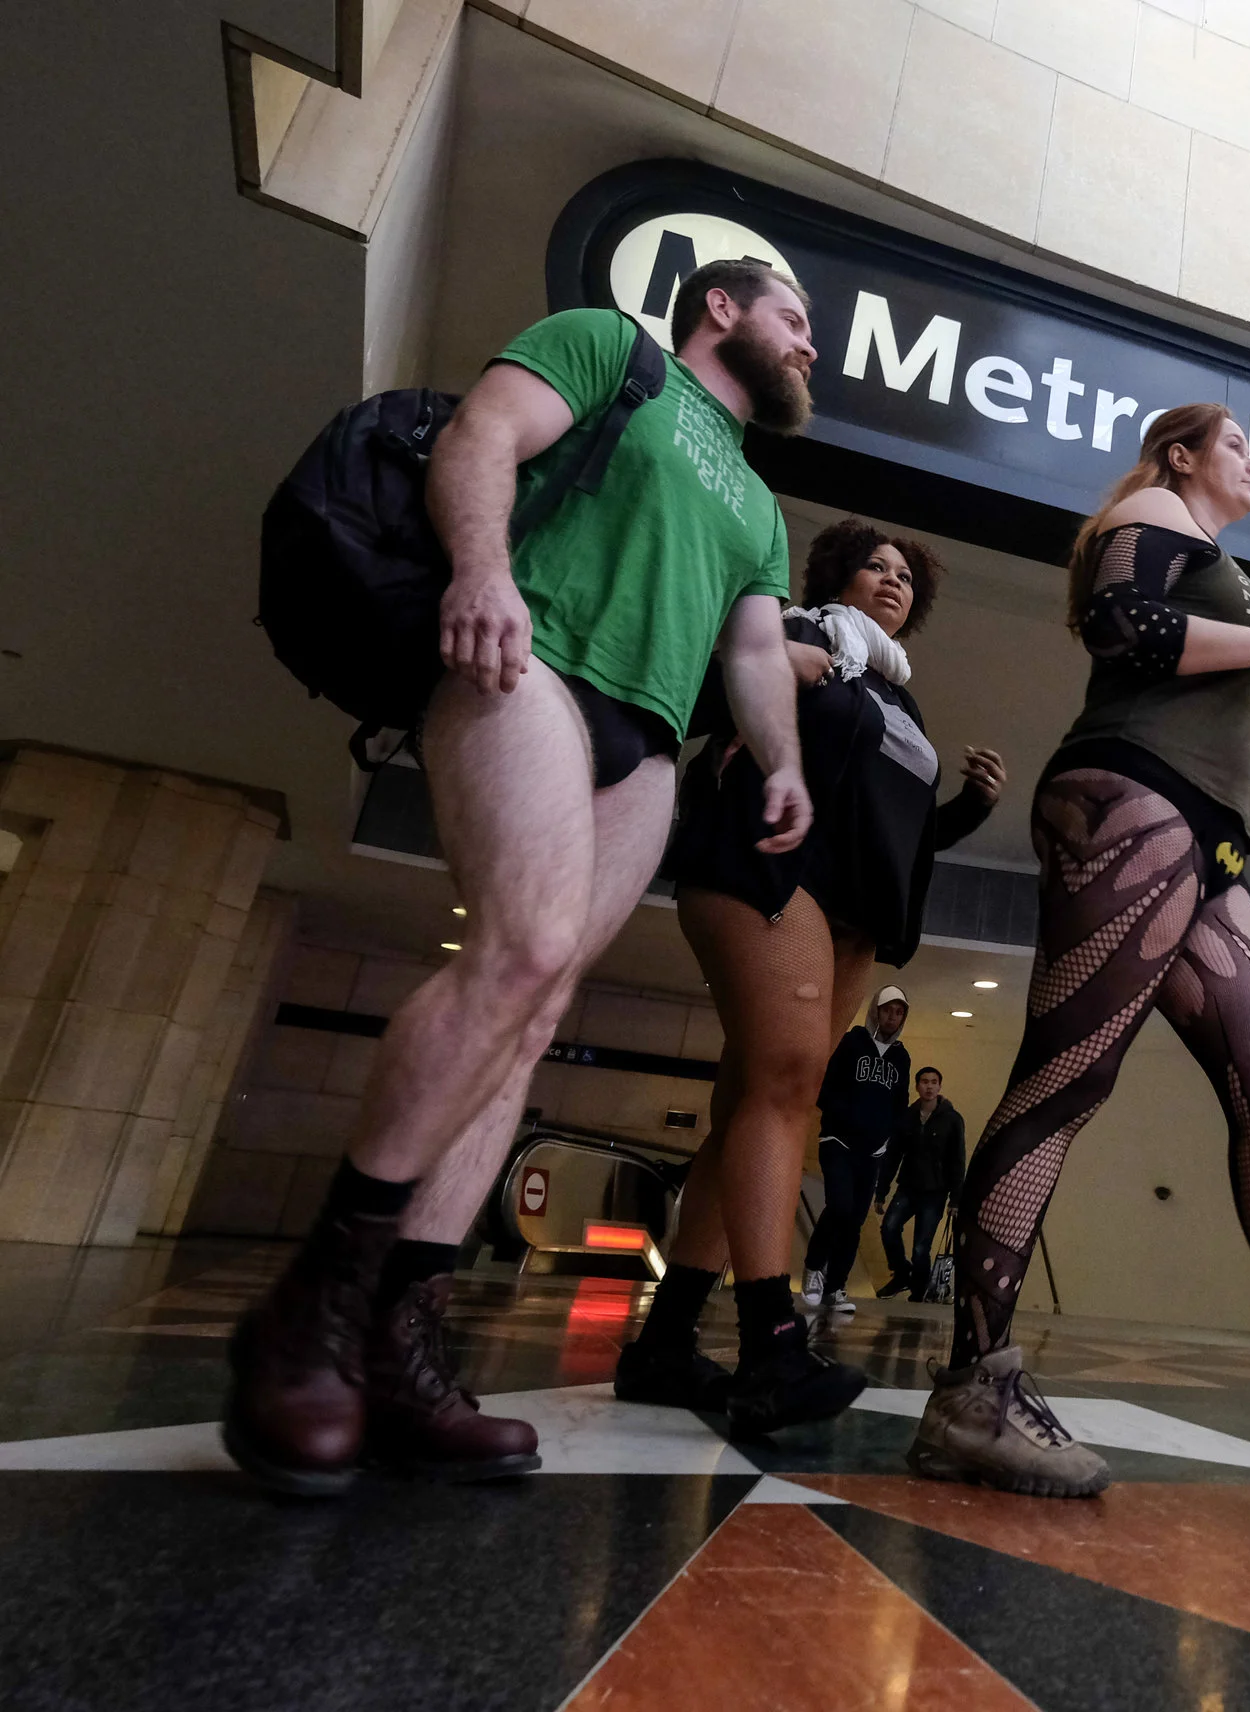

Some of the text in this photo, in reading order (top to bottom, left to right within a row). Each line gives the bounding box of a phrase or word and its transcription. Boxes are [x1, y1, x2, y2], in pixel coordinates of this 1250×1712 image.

[673, 428, 747, 526] night.
[677, 407, 746, 503] boring
[856, 1055, 899, 1089] GAP
